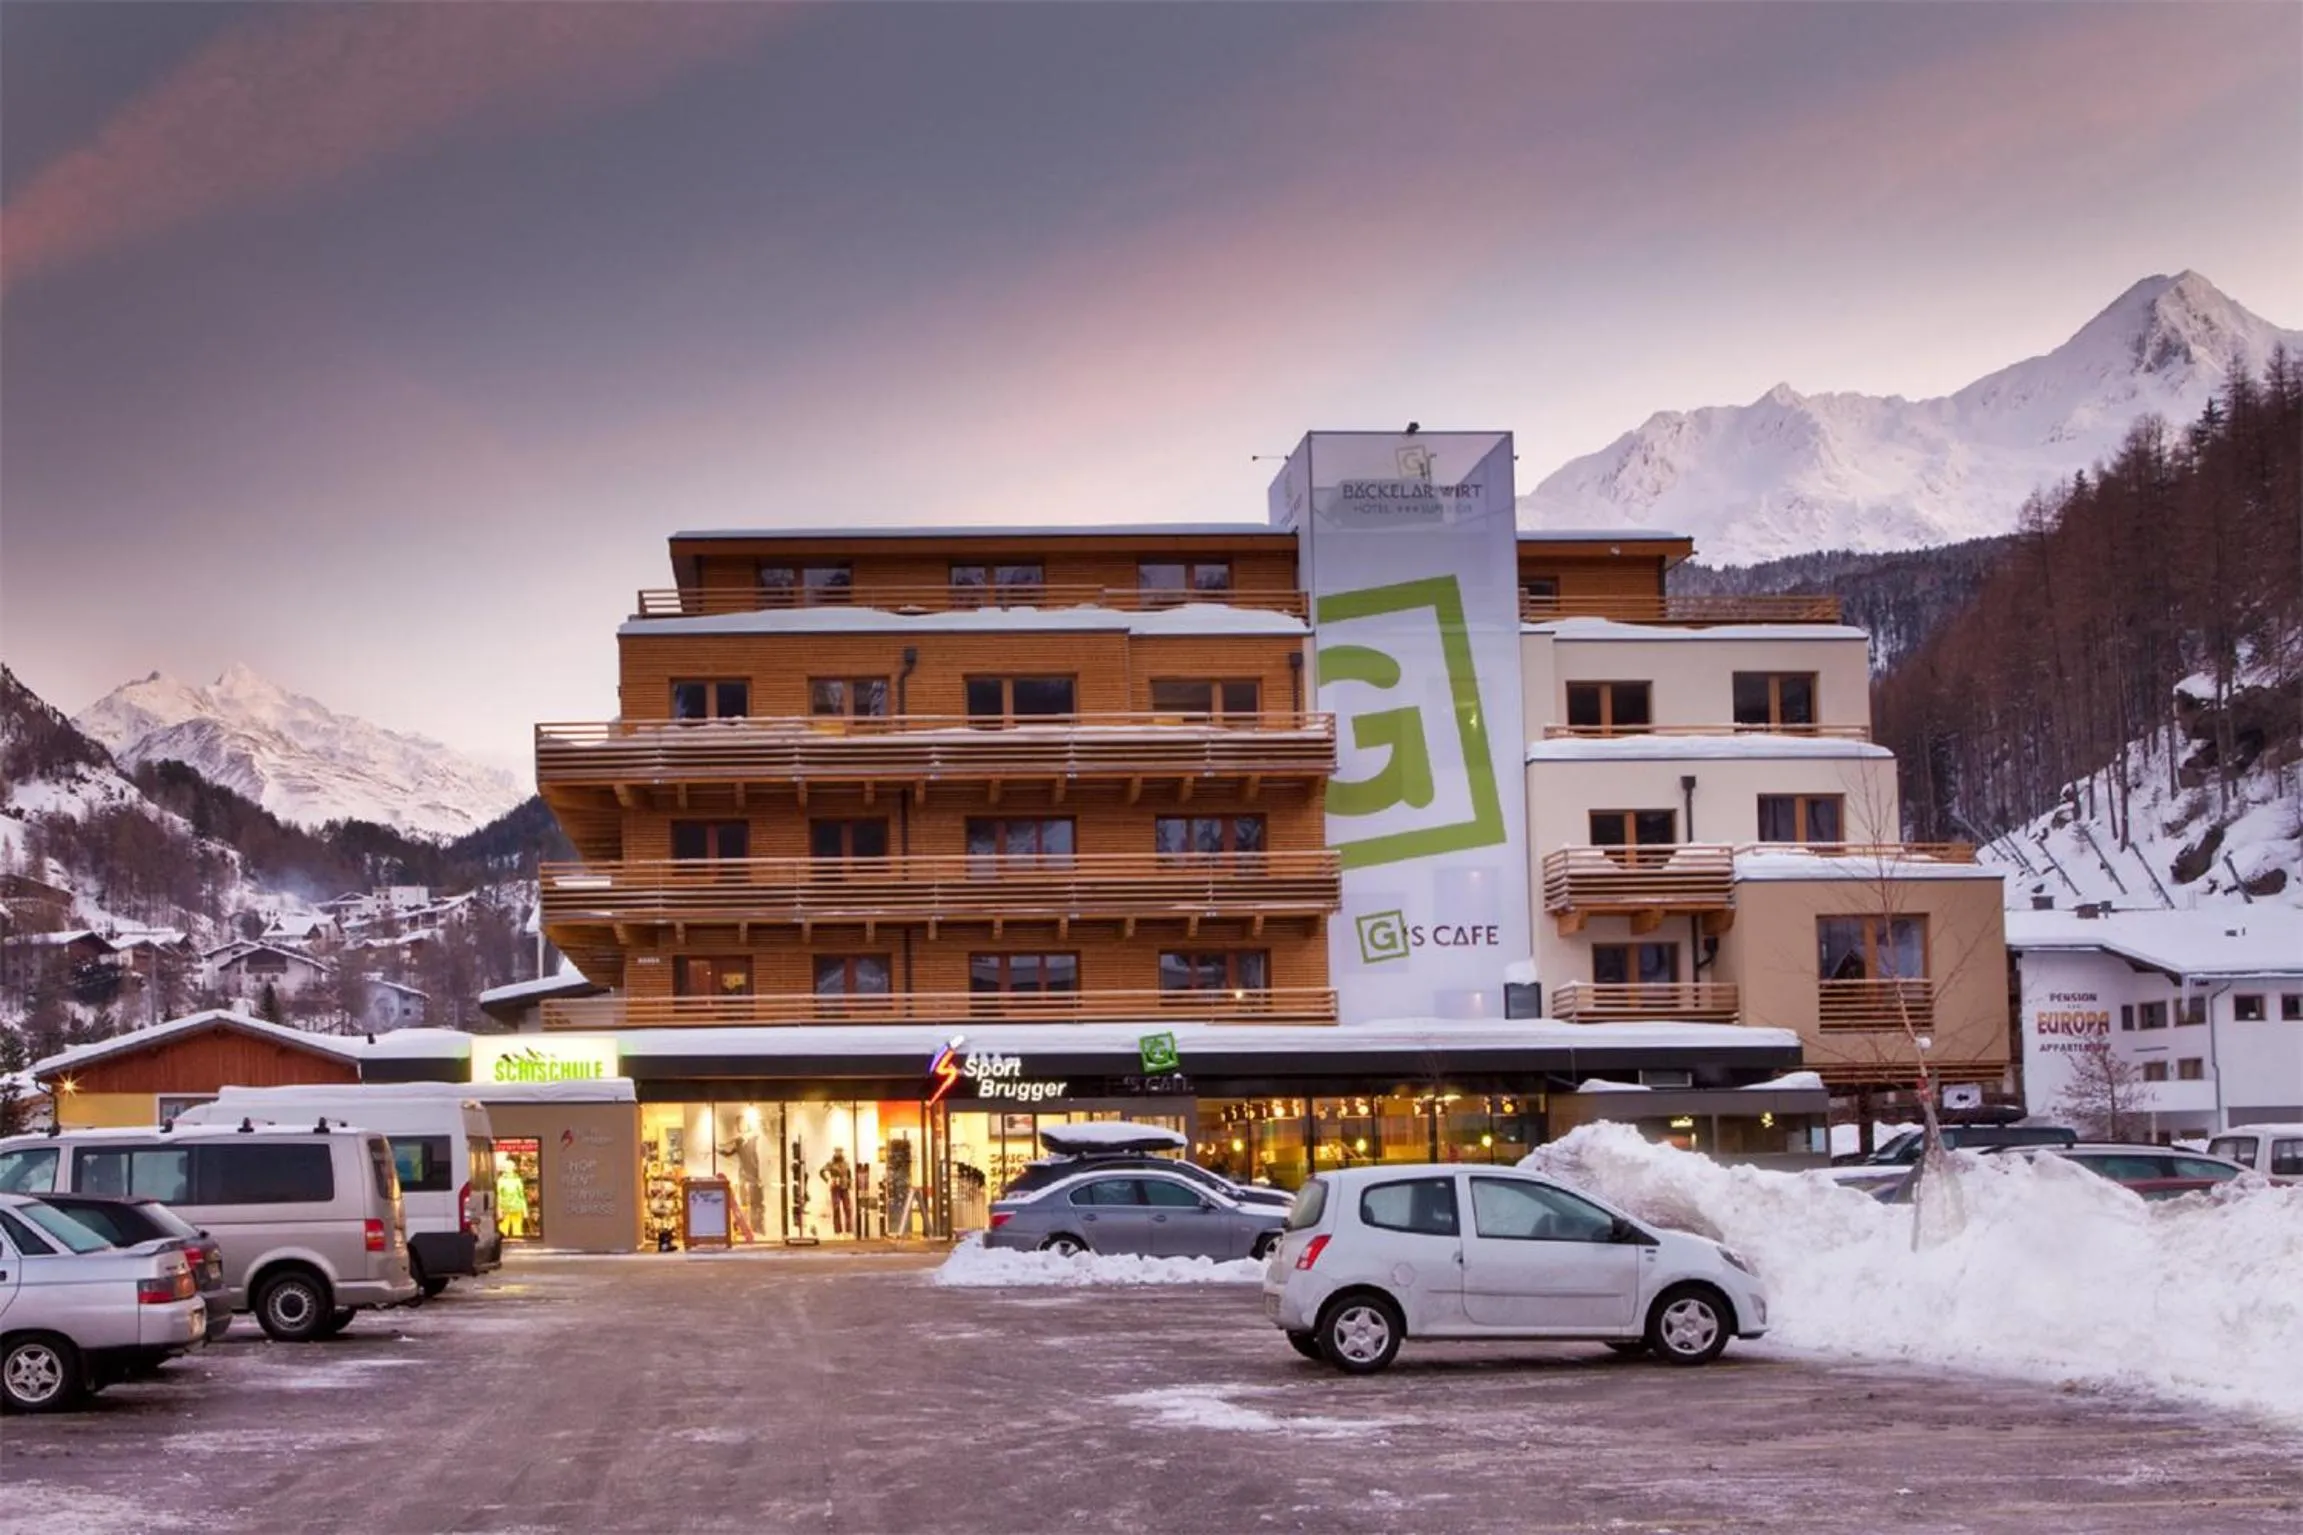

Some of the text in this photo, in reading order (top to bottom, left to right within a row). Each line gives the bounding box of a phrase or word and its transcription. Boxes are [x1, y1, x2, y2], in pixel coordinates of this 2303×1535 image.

[1342, 482, 1482, 499] BÄCKELAR WIRT
[1433, 925, 1500, 946] CAFE
[2049, 993, 2098, 1002] PENSION
[2037, 1011, 2111, 1036] EUROPA
[964, 1057, 1021, 1081] Sport
[979, 1079, 1067, 1101] Brugger
